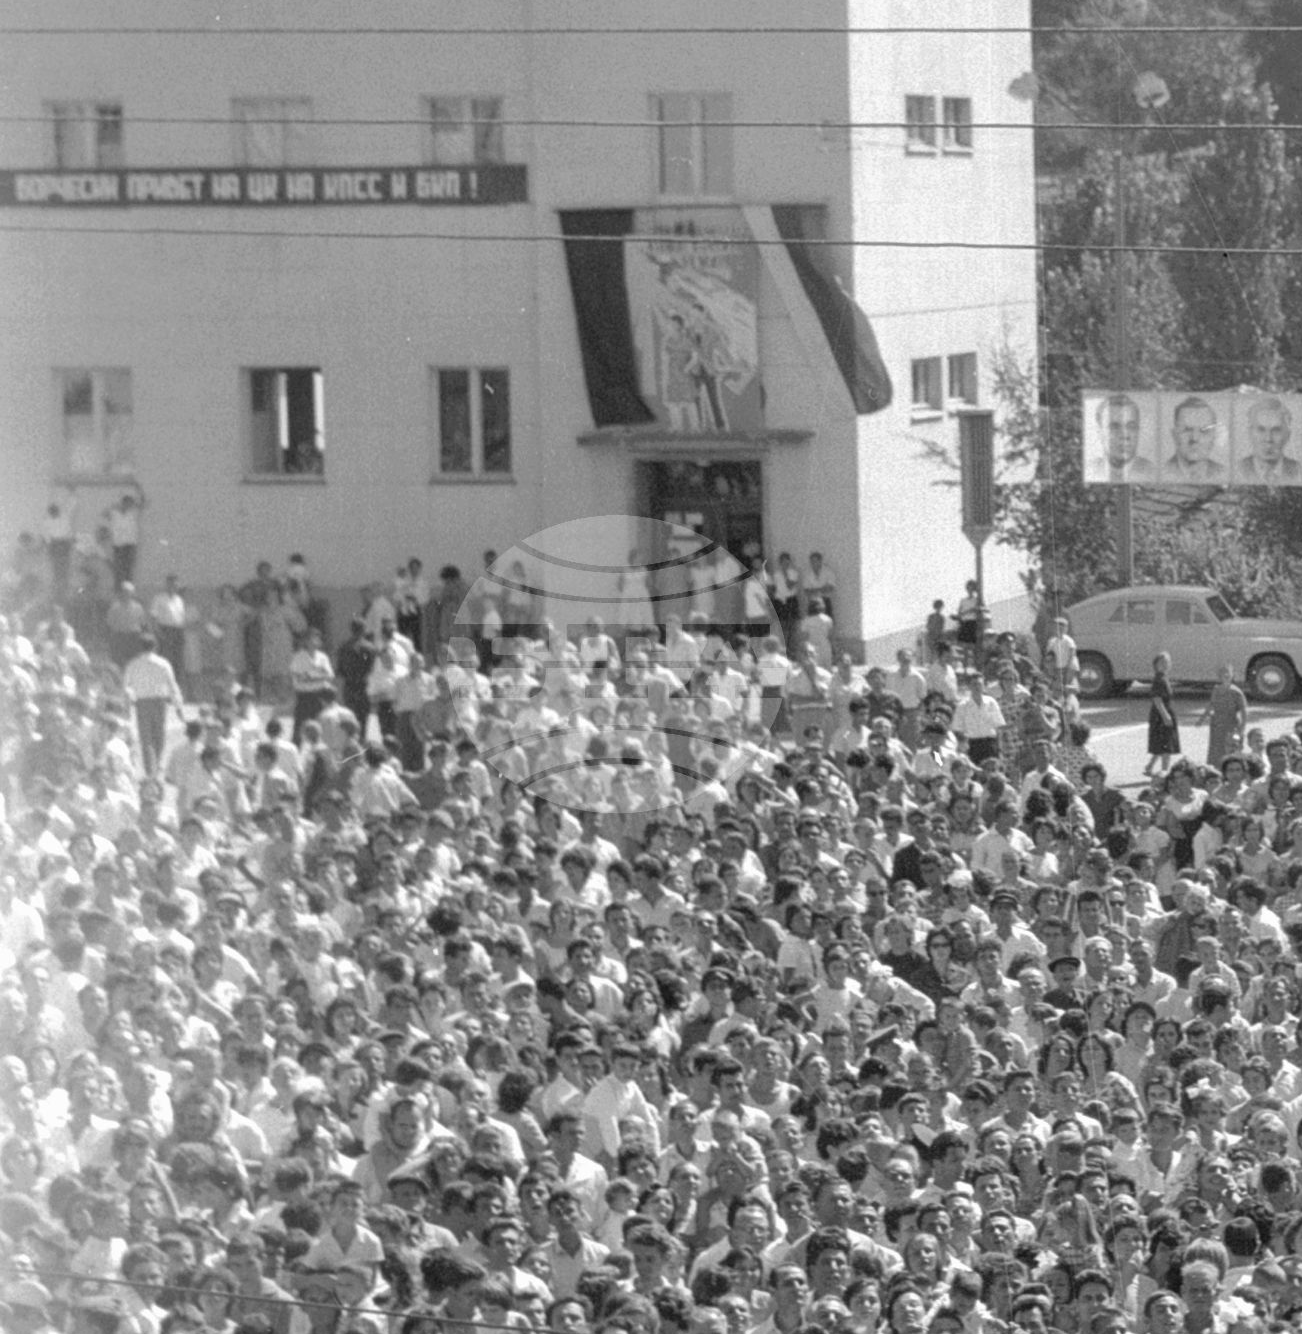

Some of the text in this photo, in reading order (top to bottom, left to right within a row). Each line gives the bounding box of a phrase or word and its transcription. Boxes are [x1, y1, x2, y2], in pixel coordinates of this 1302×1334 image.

[125, 173, 204, 200] ПРИВЕТ
[210, 173, 240, 200] НА
[247, 173, 278, 202] ЦК
[284, 172, 315, 199] НА
[323, 172, 382, 199] КПСС
[390, 172, 407, 199] И
[415, 171, 461, 198] БКП
